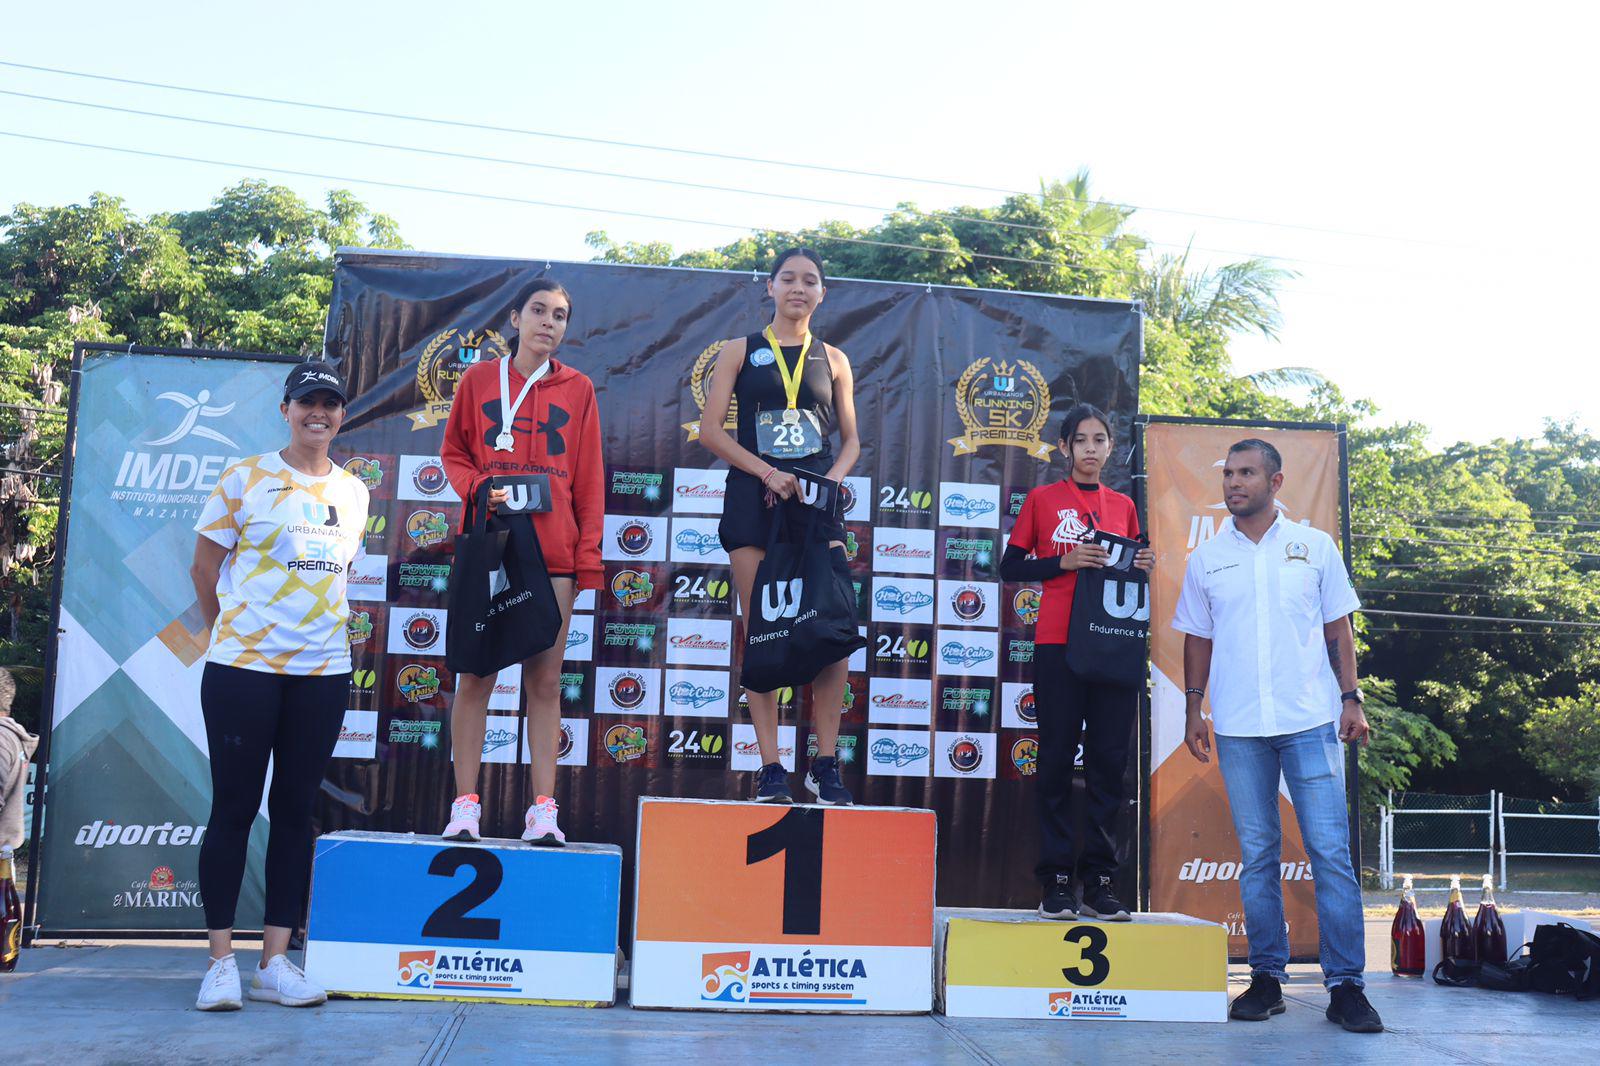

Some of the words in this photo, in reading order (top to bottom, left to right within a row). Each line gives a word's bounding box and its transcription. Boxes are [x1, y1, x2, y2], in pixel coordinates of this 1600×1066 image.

[974, 398, 1034, 410] RUNNING
[989, 409, 1023, 427] 5K
[772, 424, 805, 446] 28
[970, 430, 1036, 443] PREMIER
[612, 471, 663, 485] POWER
[612, 482, 646, 495] RIOT
[110, 490, 155, 502] INSTITUTO
[157, 494, 198, 504] MUNICIPAL
[305, 540, 337, 561] 5K
[945, 537, 993, 551] POWER
[945, 549, 977, 561] RIOT
[399, 563, 451, 577] POWER
[399, 575, 433, 587] RIOT
[498, 603, 506, 612] &
[505, 590, 533, 608] Health
[793, 608, 818, 626] ealth
[604, 622, 656, 635] POWER
[1089, 622, 1135, 638] Endurence
[1137, 629, 1145, 639] &
[567, 631, 588, 643] ake
[604, 633, 638, 646] RIOT
[942, 687, 991, 700] POWER
[942, 698, 974, 710] RIOT
[389, 719, 442, 733] POWER
[389, 731, 423, 744] RIOT
[746, 806, 825, 935] 1
[175, 880, 198, 892] Coffee
[421, 846, 504, 940] 2
[1061, 925, 1110, 986] 3
[435, 972, 458, 980] sports
[466, 973, 488, 983] timing
[751, 982, 780, 991] sports
[791, 981, 820, 992] timing
[822, 982, 854, 993] system
